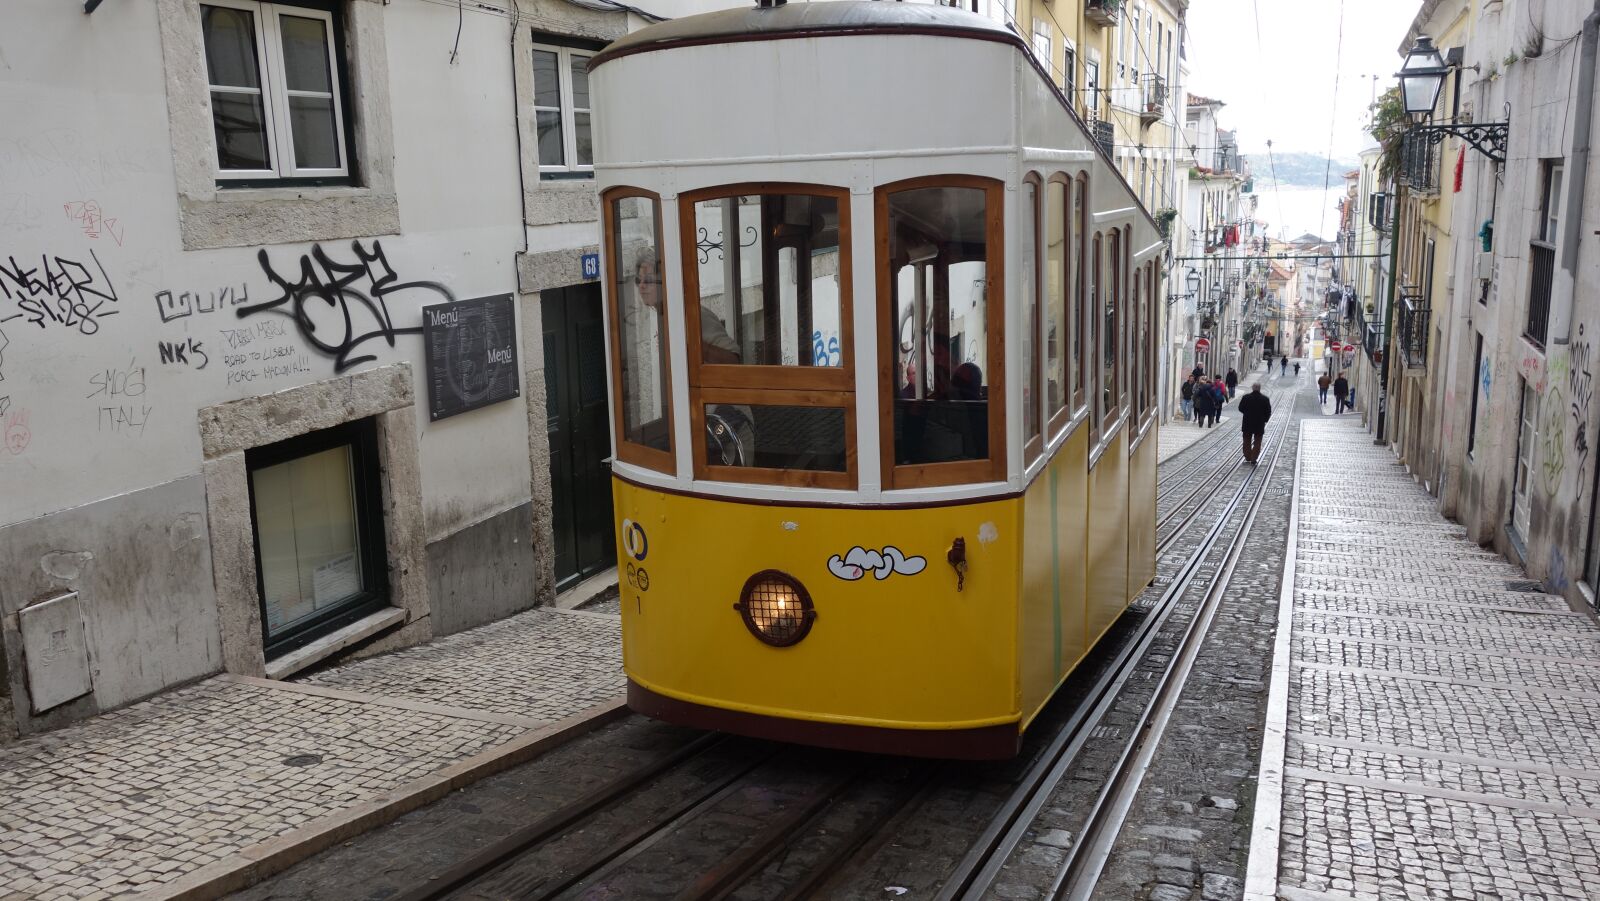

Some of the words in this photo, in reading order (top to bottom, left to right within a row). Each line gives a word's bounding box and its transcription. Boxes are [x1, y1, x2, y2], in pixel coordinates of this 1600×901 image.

[431, 307, 458, 327] Menú
[487, 345, 512, 364] Menú
[98, 404, 153, 437] ITALY
